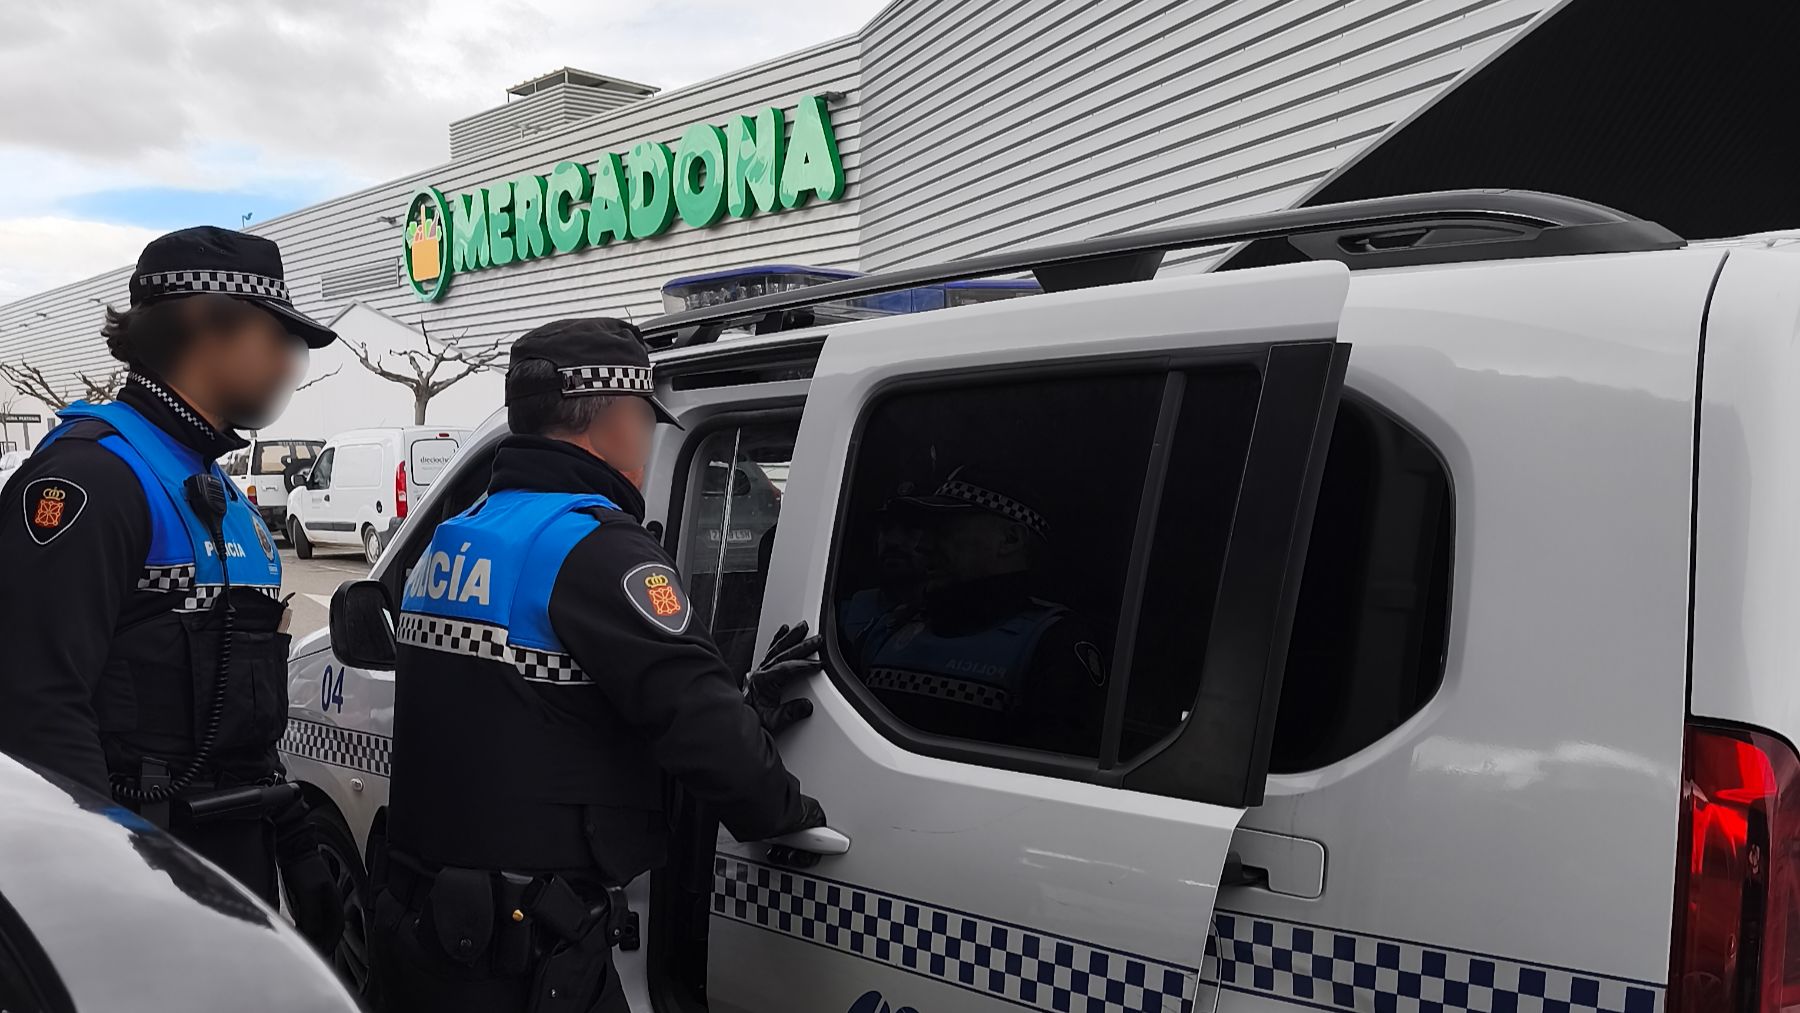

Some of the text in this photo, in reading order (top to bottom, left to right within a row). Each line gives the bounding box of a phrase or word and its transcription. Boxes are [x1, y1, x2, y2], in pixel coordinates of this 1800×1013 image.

[453, 95, 845, 272] MERCADONA
[204, 539, 246, 558] PICÍA
[321, 664, 345, 713] 04
